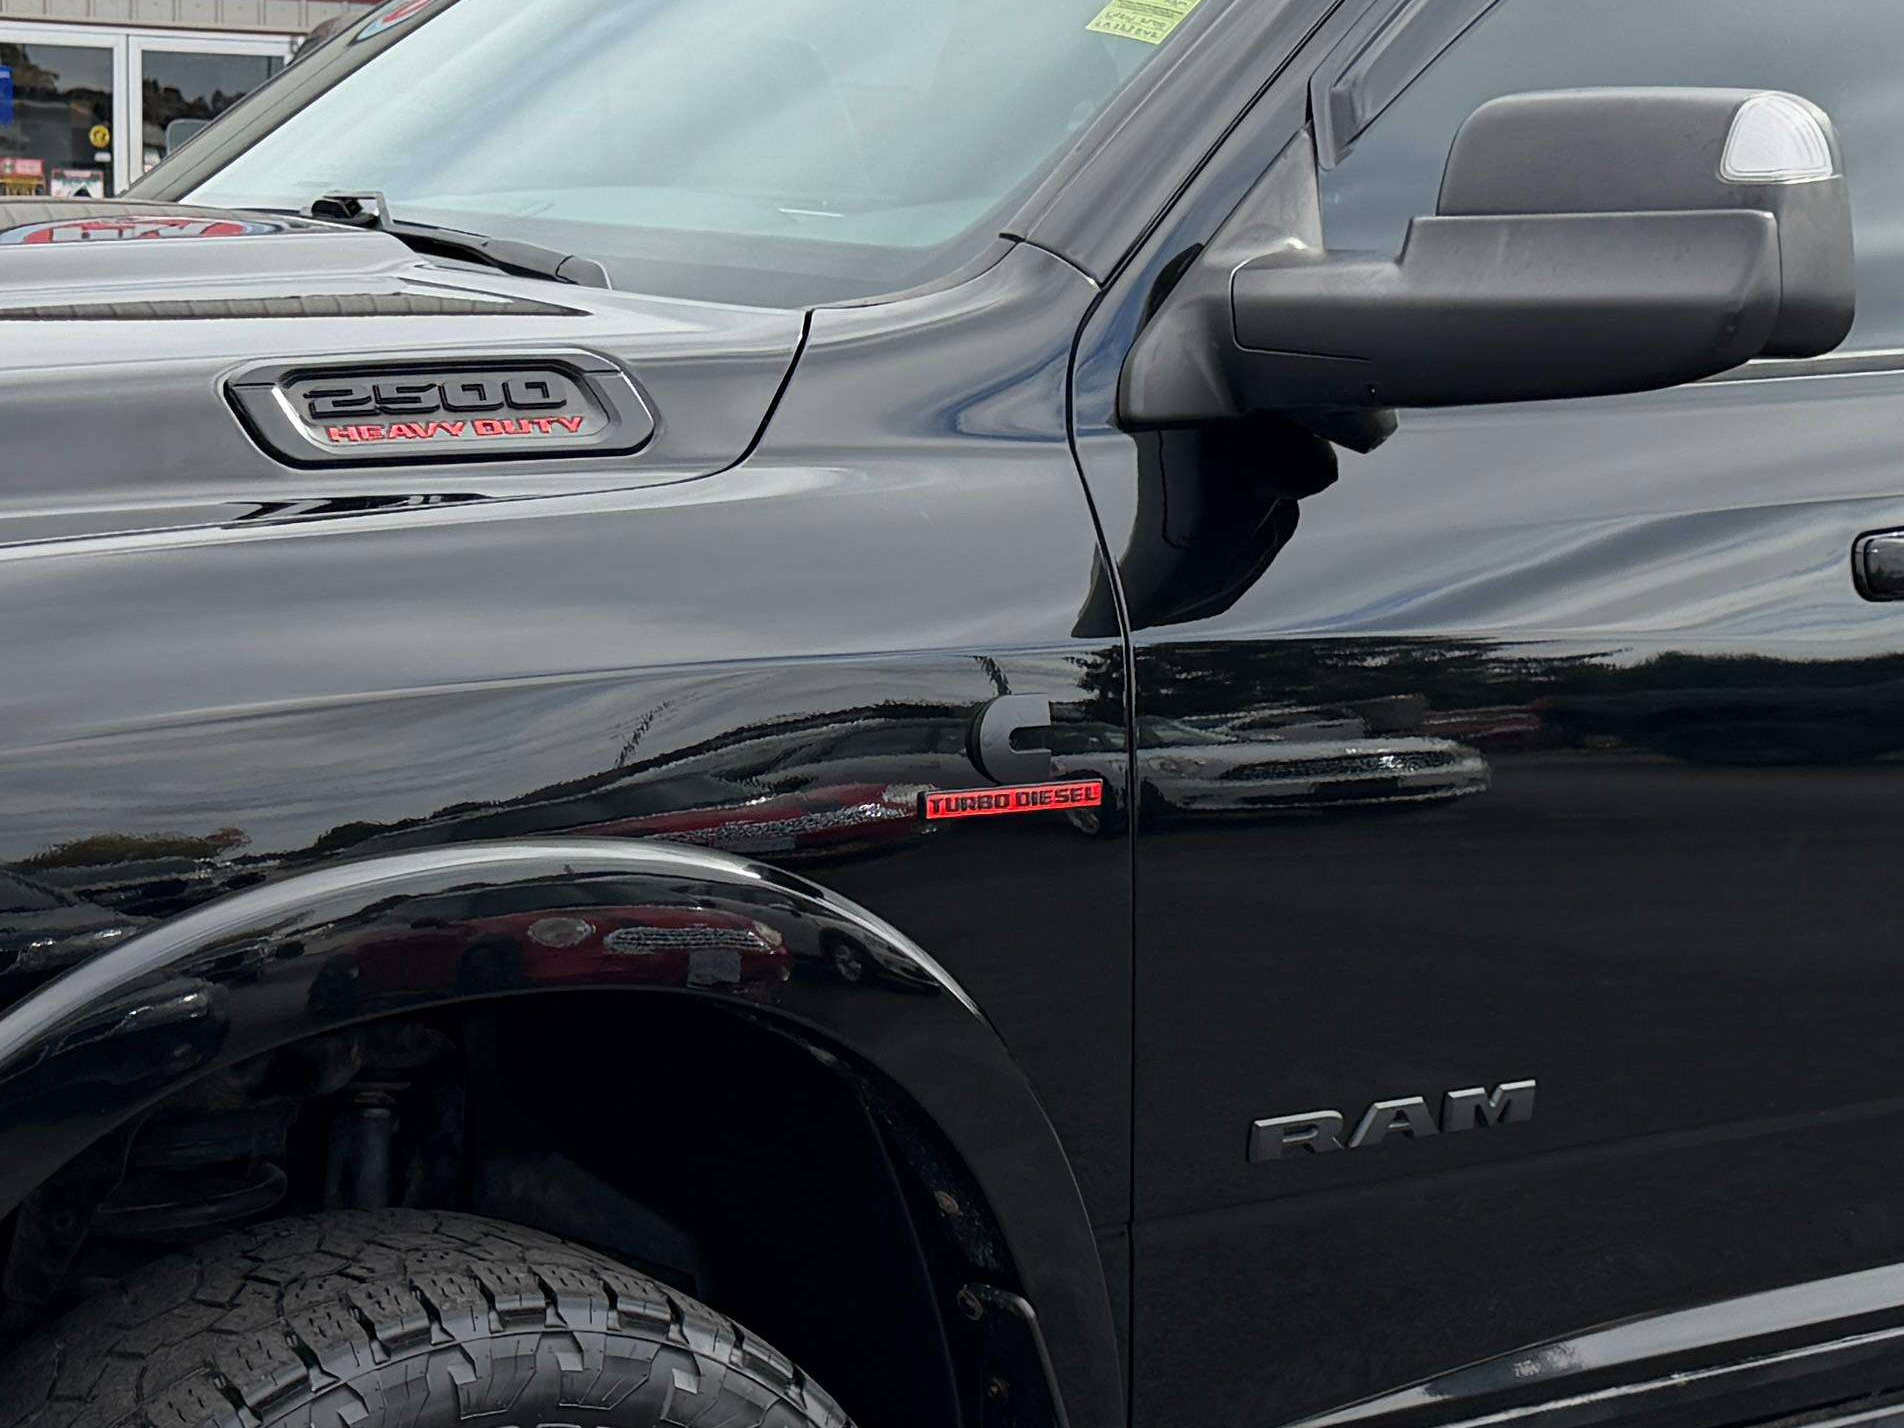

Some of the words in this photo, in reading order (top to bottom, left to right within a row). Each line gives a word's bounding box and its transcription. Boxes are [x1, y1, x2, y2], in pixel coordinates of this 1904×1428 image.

[303, 382, 567, 419] 2500
[327, 421, 464, 443] HEAVY
[472, 417, 584, 437] DUTY
[928, 793, 1010, 814] TURBO
[1015, 786, 1099, 807] DIESEL
[1247, 1079, 1537, 1164] RAM
